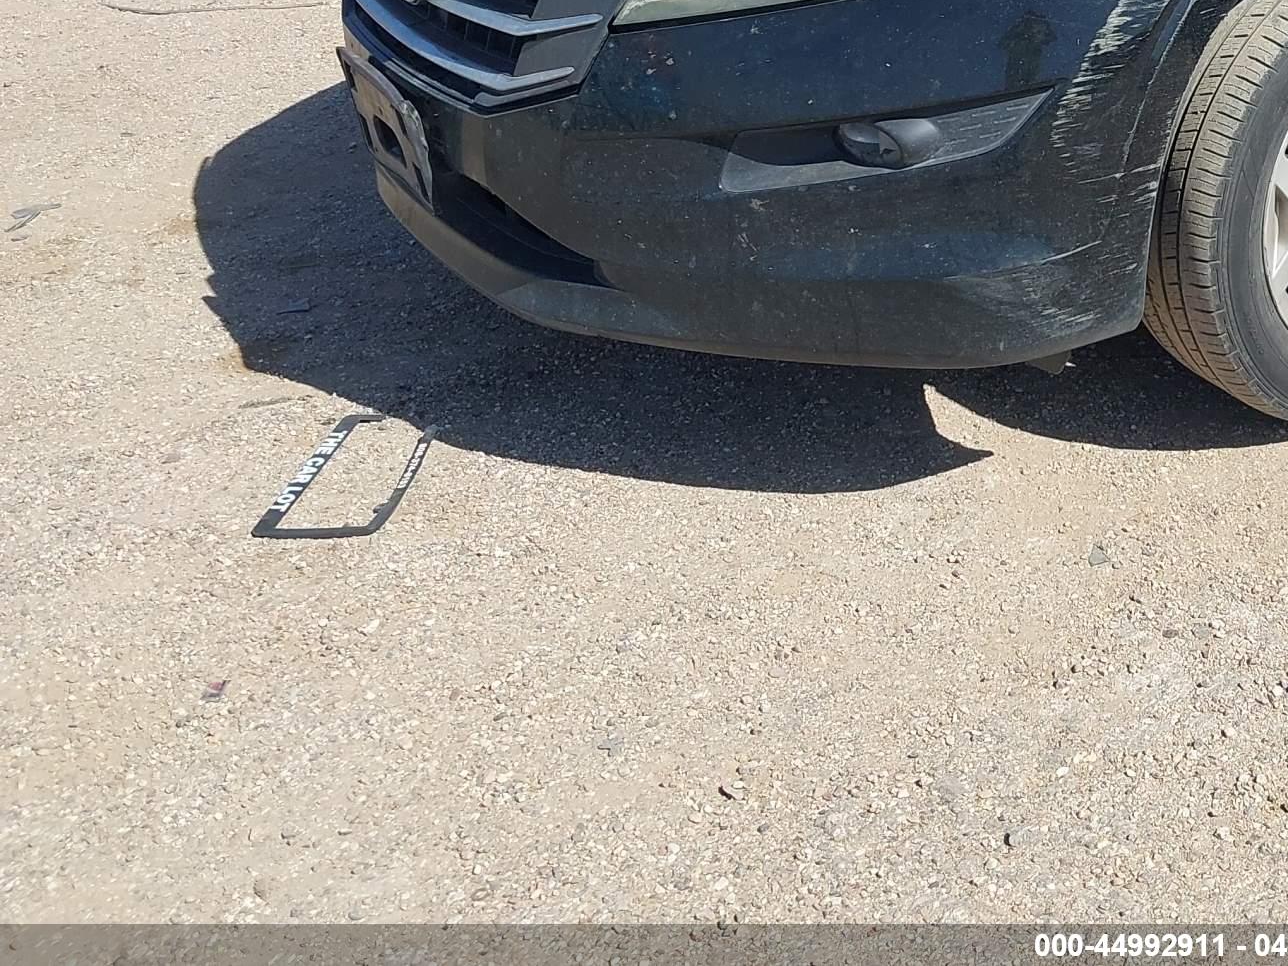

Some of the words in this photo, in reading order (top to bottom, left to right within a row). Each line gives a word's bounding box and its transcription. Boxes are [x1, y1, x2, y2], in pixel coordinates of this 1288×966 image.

[315, 430, 349, 454] THE
[290, 457, 325, 484] CAR
[269, 486, 304, 512] LOT
